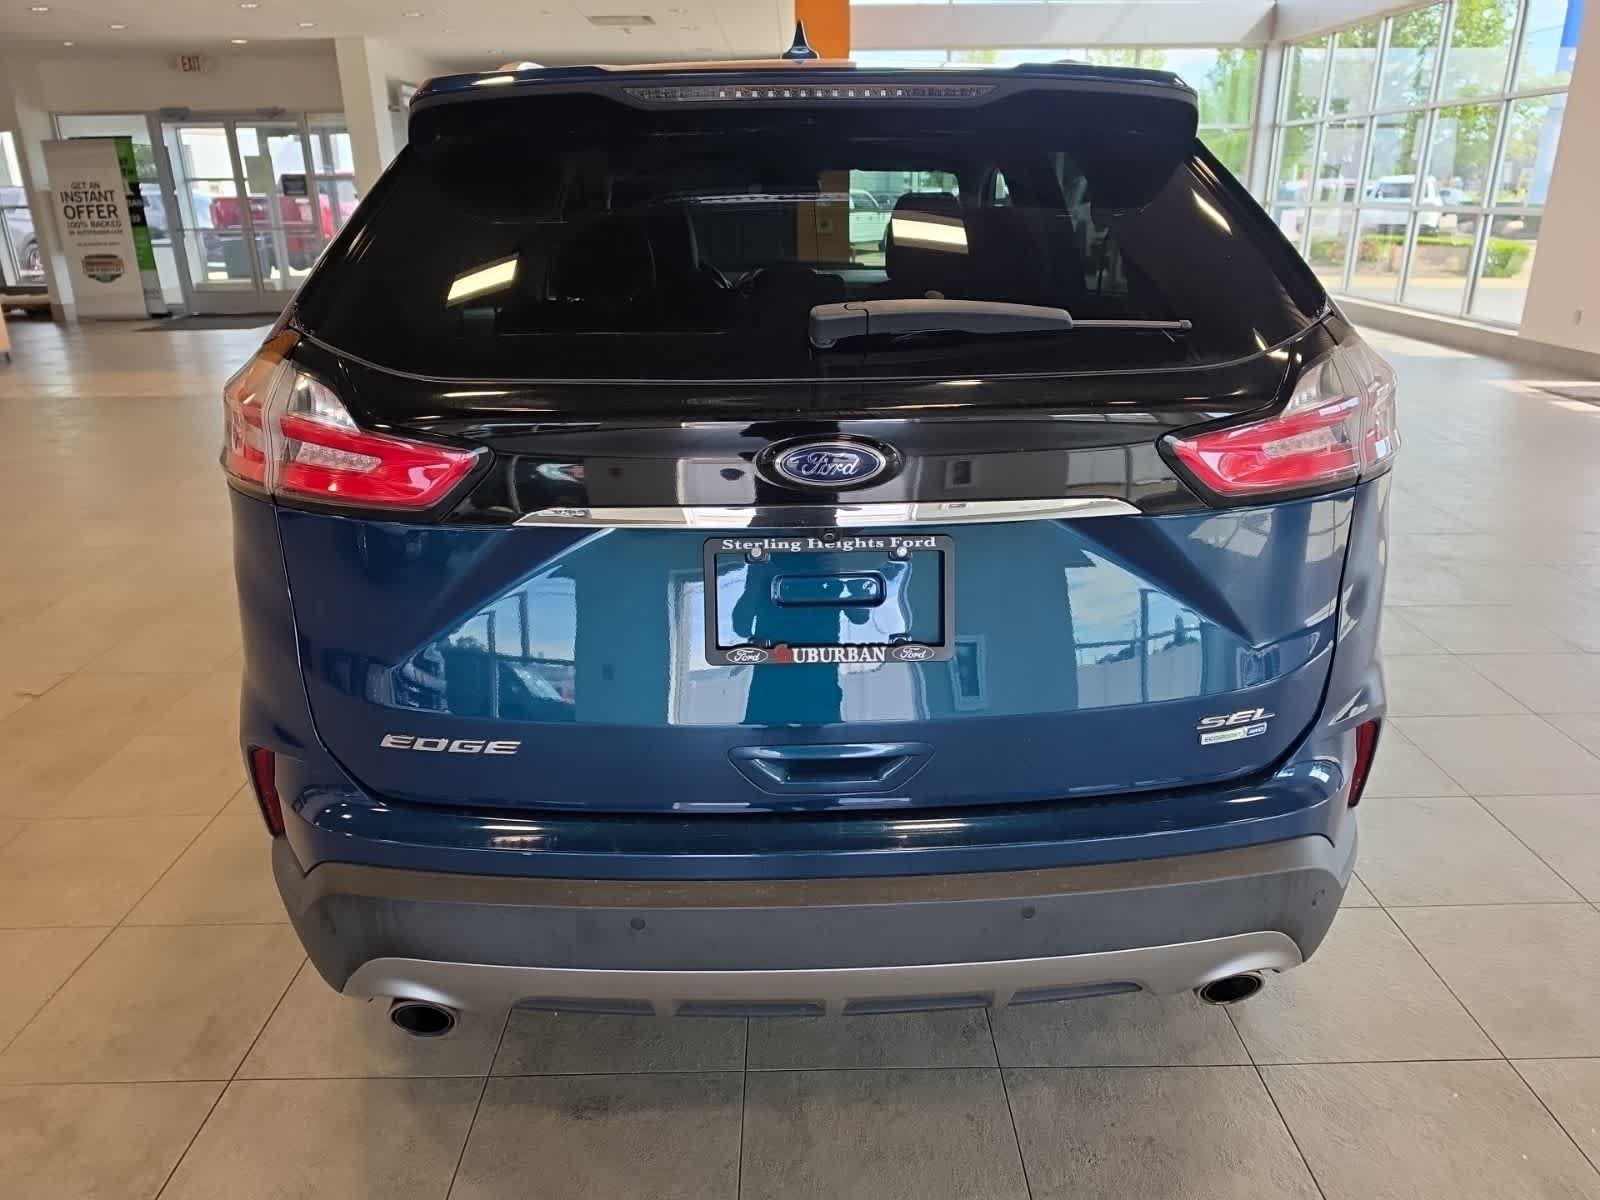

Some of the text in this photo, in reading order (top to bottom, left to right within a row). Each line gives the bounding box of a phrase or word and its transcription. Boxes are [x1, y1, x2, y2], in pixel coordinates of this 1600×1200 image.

[181, 56, 200, 71] EXIT
[60, 190, 115, 203] INSTANT
[64, 204, 118, 219] OFFER
[787, 451, 861, 475] Ford
[721, 536, 936, 551] Sterling Heights Ford
[734, 648, 762, 663] Ford
[900, 647, 928, 661] Ford
[1196, 707, 1276, 730] SEL
[380, 733, 521, 754] EDGE
